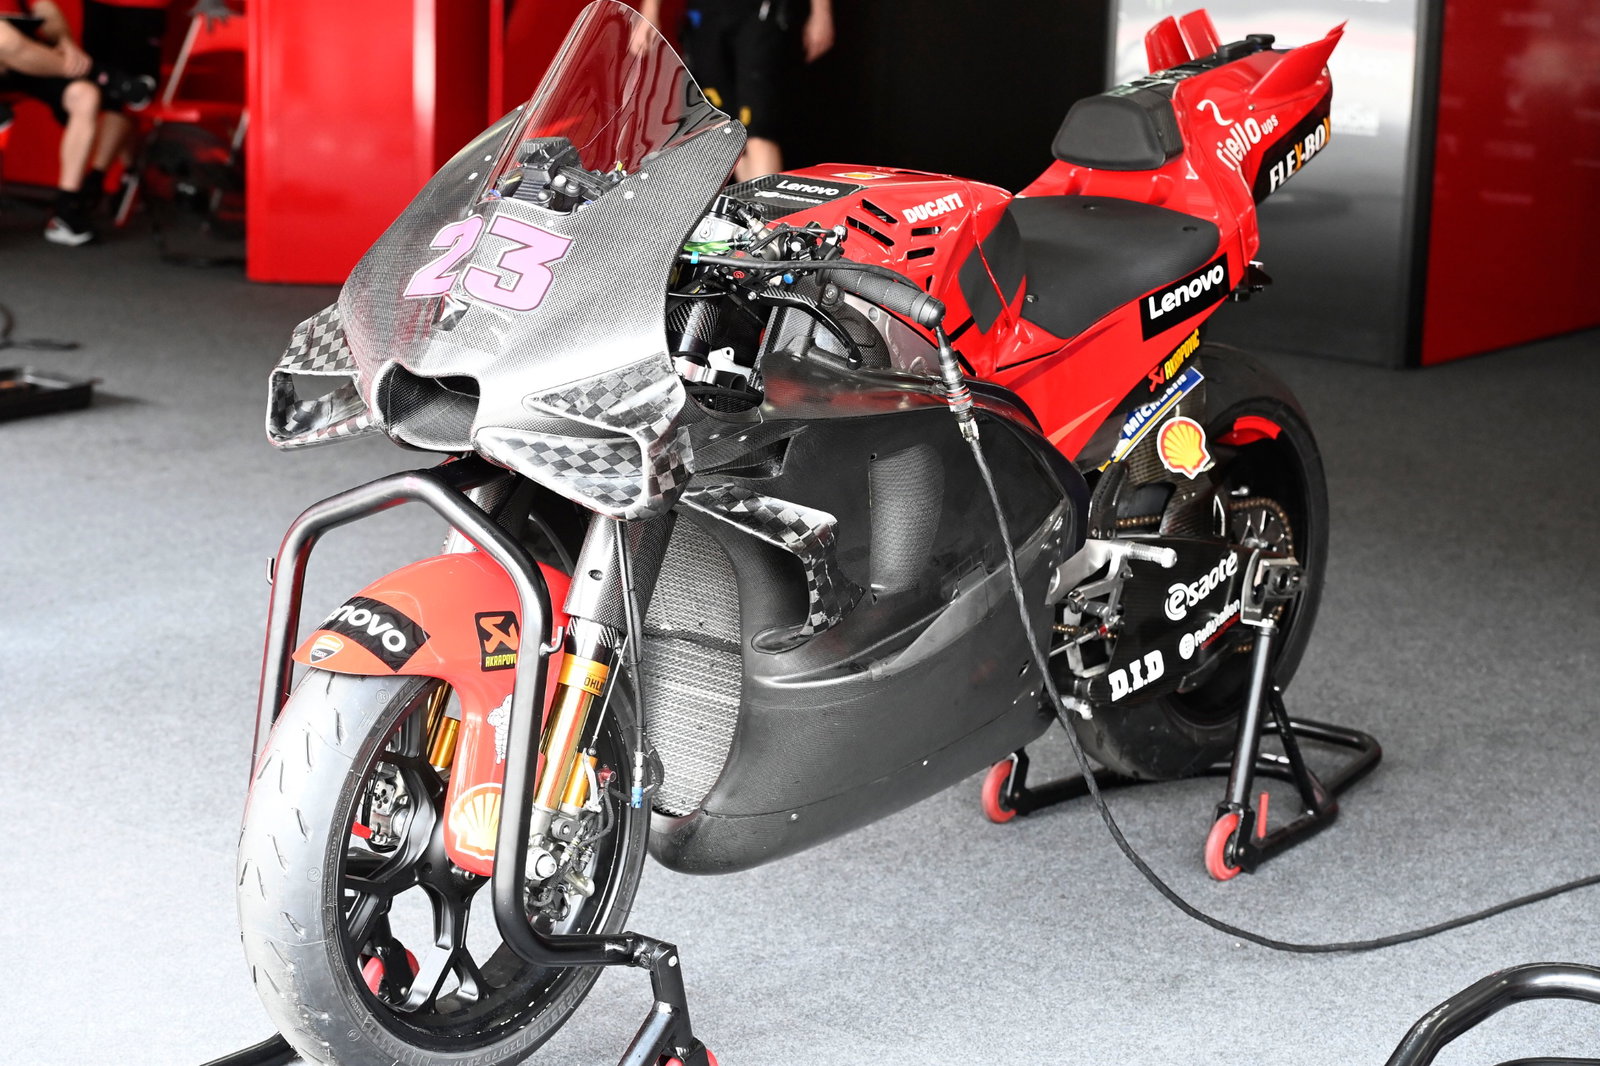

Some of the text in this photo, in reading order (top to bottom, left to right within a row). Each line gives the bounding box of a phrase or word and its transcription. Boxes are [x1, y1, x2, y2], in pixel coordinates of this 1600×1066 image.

[1260, 114, 1279, 135] ups
[775, 179, 840, 196] Lenovo
[901, 192, 965, 224] DUCATI
[402, 213, 576, 313] 23
[1148, 264, 1224, 320] Lenovo
[322, 604, 407, 653] novo
[1107, 649, 1165, 702] D.I.D
